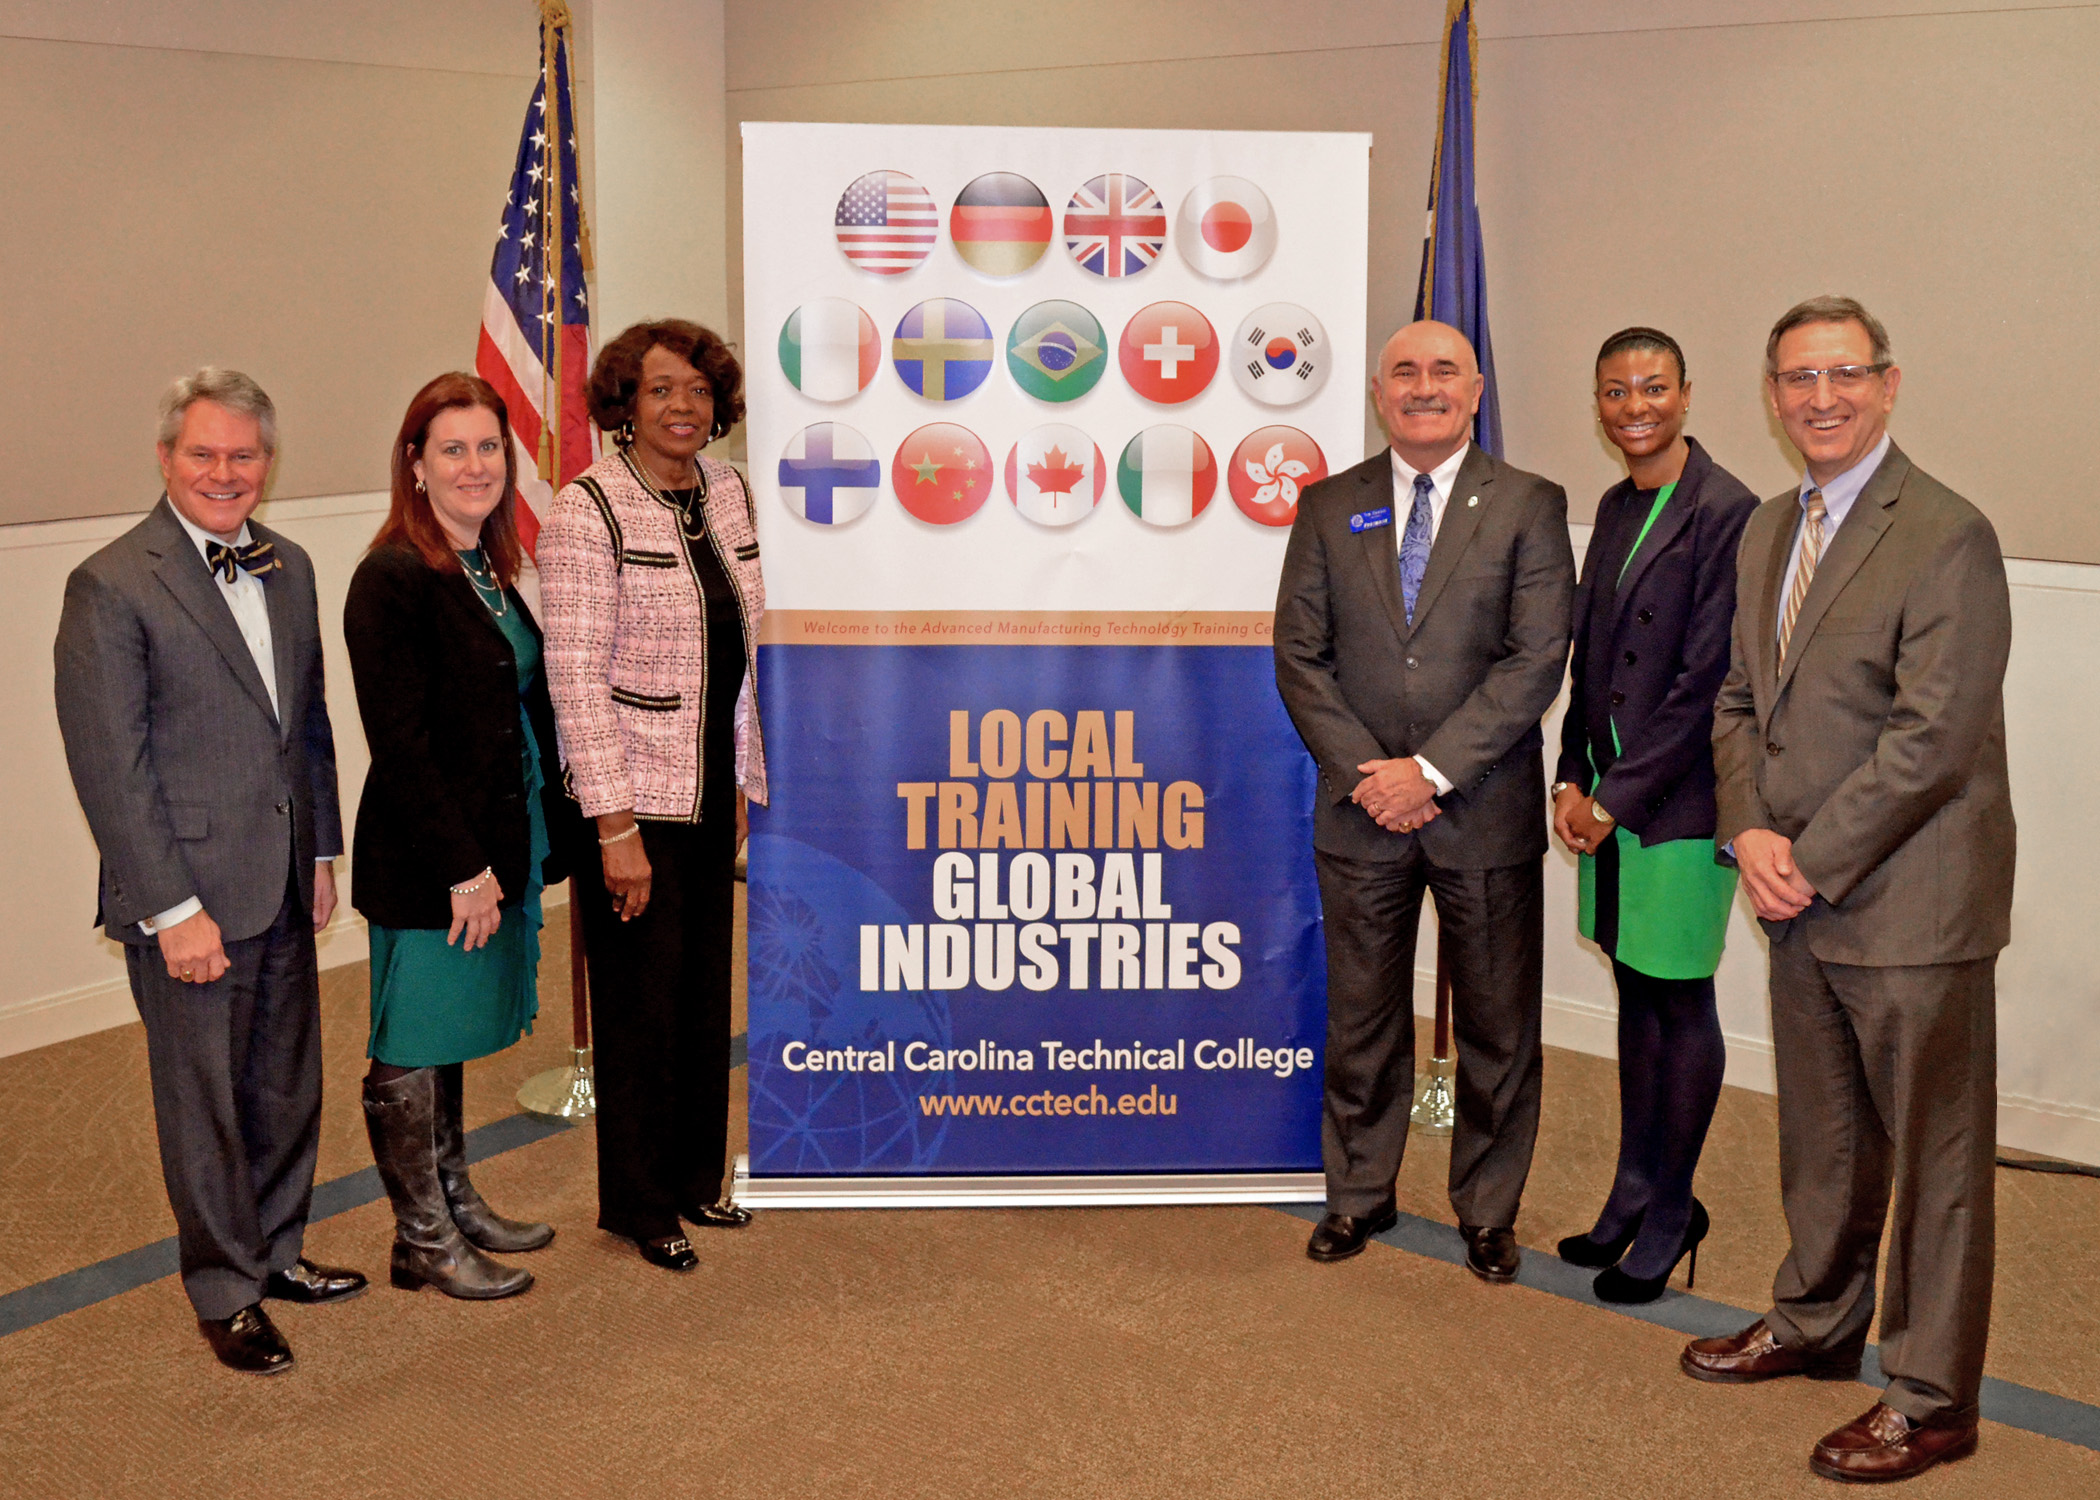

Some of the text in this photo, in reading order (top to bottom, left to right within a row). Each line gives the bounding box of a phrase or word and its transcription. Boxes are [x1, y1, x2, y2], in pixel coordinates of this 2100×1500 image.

[803, 621, 869, 635] Welcome
[875, 623, 889, 635] to
[894, 622, 917, 635] the
[921, 621, 993, 635] Advanced
[998, 622, 1101, 638] Manufacturing
[1107, 622, 1188, 638] Technology
[1193, 622, 1249, 638] Training
[949, 709, 1144, 779] LOCAL
[897, 780, 1205, 850] TRAINING
[932, 851, 1171, 921] GLOBAL
[859, 921, 1242, 991] INDUSTRIES
[781, 1038, 1314, 1077] Central Carolina Technical College
[919, 1084, 1177, 1116] www.cctech.edu
